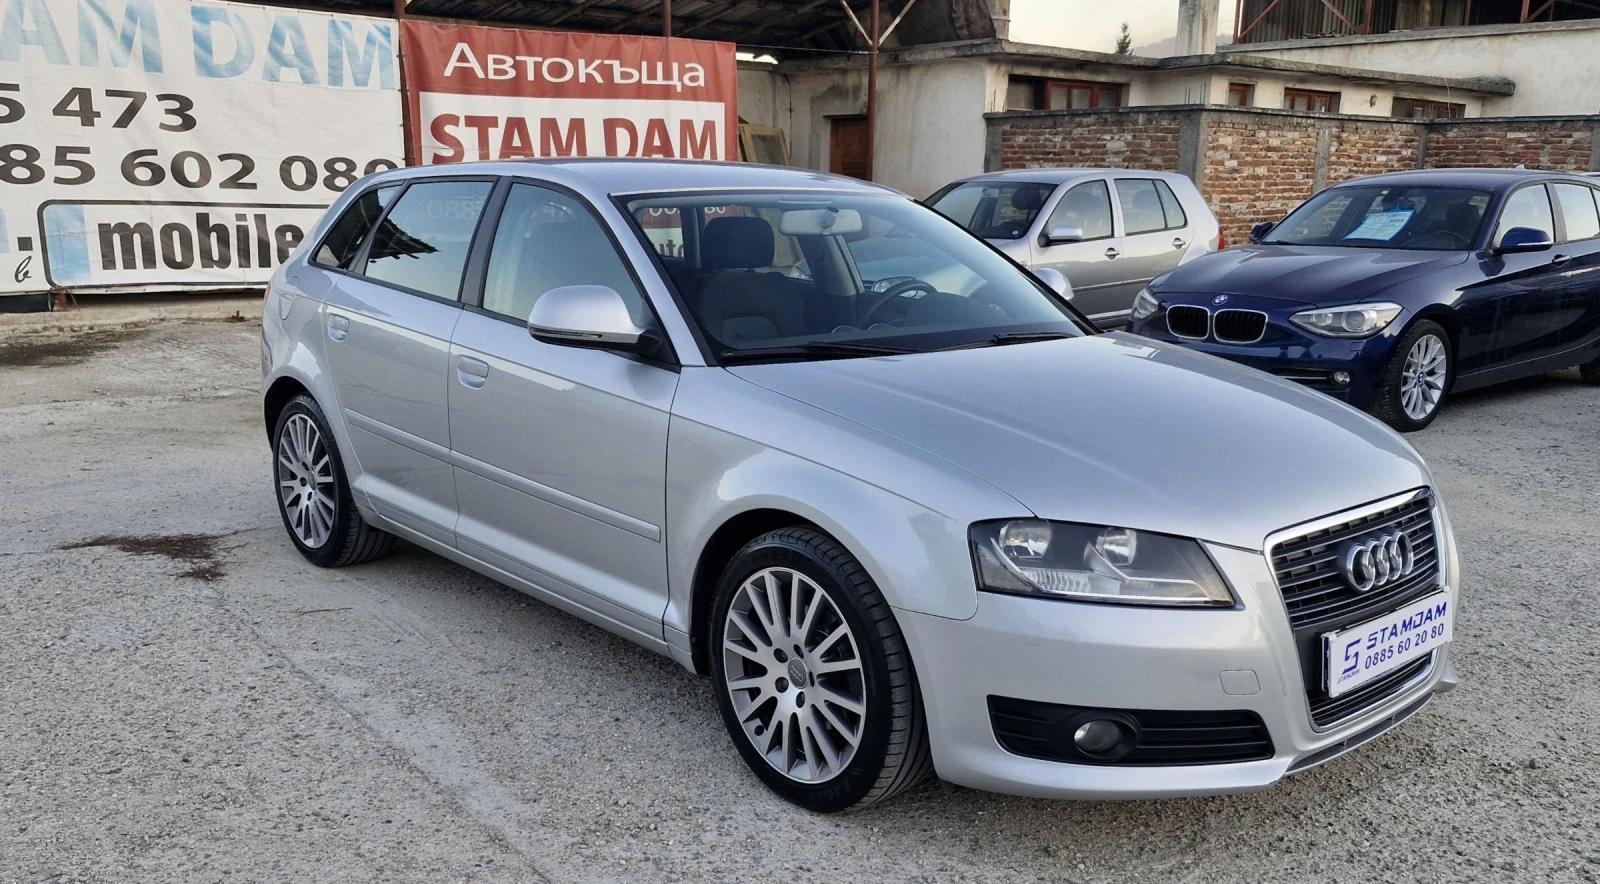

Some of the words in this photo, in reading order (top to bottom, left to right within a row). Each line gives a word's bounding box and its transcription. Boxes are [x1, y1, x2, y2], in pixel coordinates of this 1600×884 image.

[190, 5, 396, 91] DAM
[443, 42, 706, 93] Автокъща
[52, 87, 197, 133] 473
[430, 113, 588, 164] STAM
[602, 117, 719, 161] DAM
[120, 148, 258, 190] 602
[98, 212, 304, 271] mobile
[1365, 645, 1394, 669] 0885
[1397, 638, 1411, 654] 60
[1414, 630, 1428, 647] 20
[1431, 622, 1444, 639] 80
